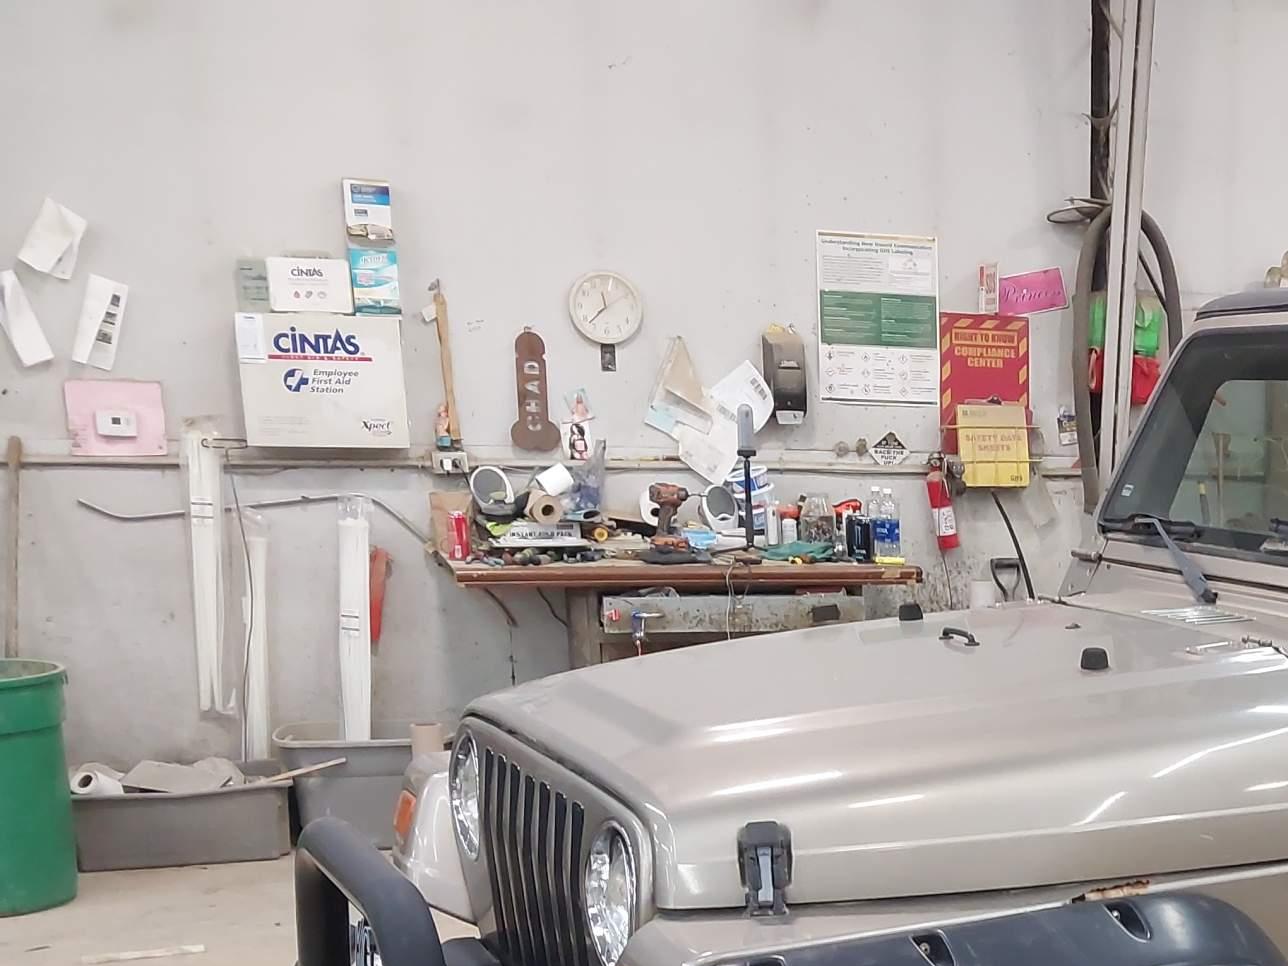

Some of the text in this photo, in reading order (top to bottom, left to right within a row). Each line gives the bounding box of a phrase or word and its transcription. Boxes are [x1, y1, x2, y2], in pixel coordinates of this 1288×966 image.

[273, 326, 361, 356] CINTAS
[954, 345, 1017, 358] COMPLIANCE
[967, 357, 1004, 368] CENTER
[313, 368, 360, 378] Employee
[312, 377, 352, 386] First Aid
[309, 386, 345, 394] Station
